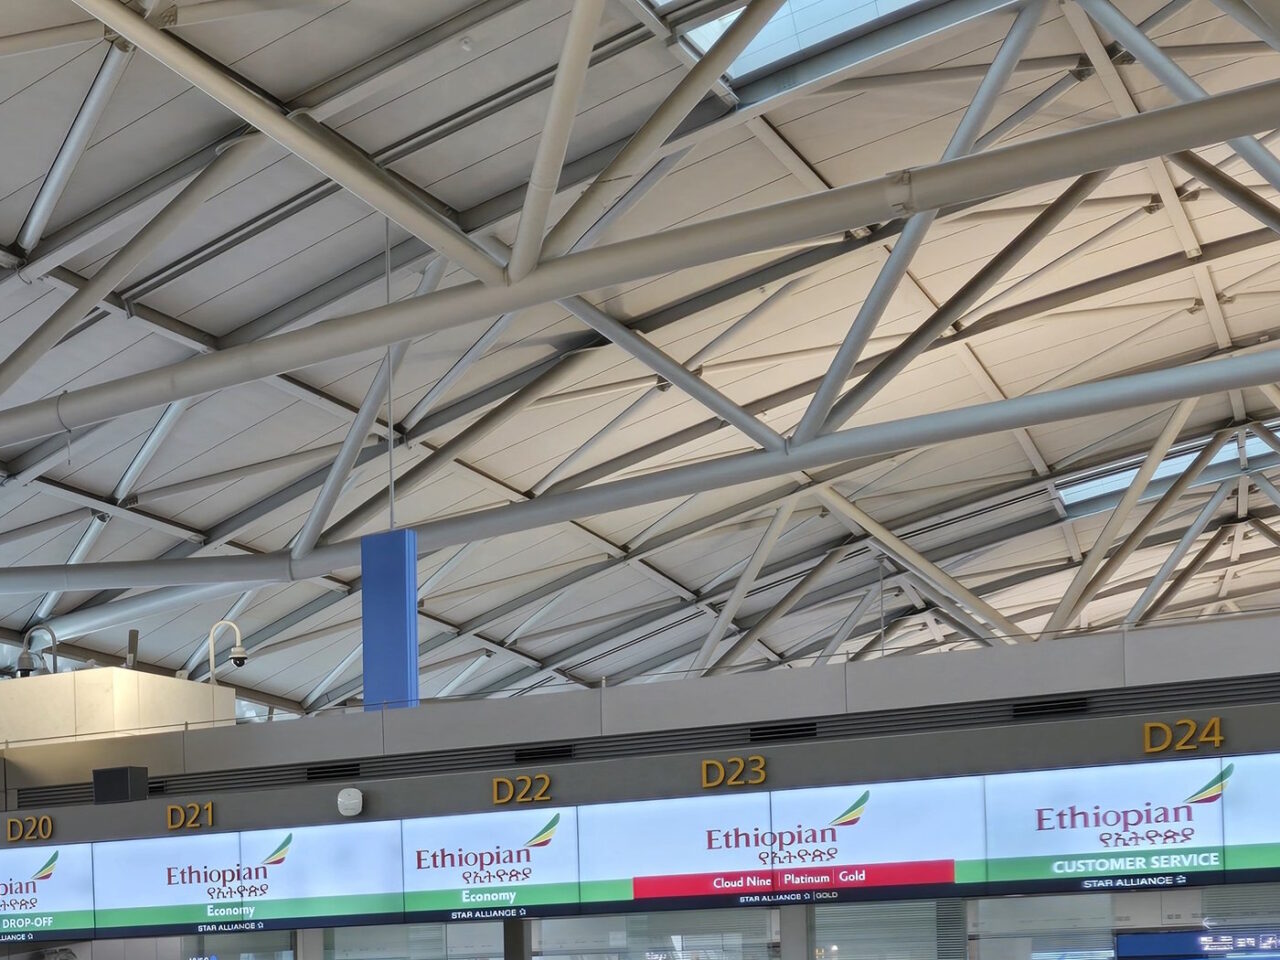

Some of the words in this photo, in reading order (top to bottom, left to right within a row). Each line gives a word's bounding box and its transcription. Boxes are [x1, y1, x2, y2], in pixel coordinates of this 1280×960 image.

[1143, 716, 1225, 754] D24
[701, 755, 767, 789] D23
[492, 773, 552, 805] D22
[167, 801, 214, 830] D21
[1035, 799, 1193, 832] Ethiopian
[7, 815, 53, 842] D20
[706, 825, 838, 851] Ethiopian
[416, 845, 531, 872] Ethiopian
[1053, 857, 1147, 873] CUSTOMER
[1151, 853, 1220, 867] SERVICE
[167, 864, 268, 887] Ethiopian
[713, 877, 744, 889] Cloud
[747, 875, 771, 887] Nine
[784, 873, 830, 885] Platinum
[839, 870, 866, 882] Gold
[1083, 879, 1113, 888] STAR
[1115, 876, 1173, 887] ALLIANCE
[462, 890, 517, 905] Economy
[740, 895, 760, 903] STAR
[761, 893, 802, 902] ALLIANCE
[207, 904, 256, 918] Economy
[451, 911, 473, 919] STAR
[475, 909, 517, 918] ALLIANCE
[3, 916, 54, 929] DROP-OFF
[198, 924, 217, 932] STAR
[218, 922, 256, 931] ALLIANCE
